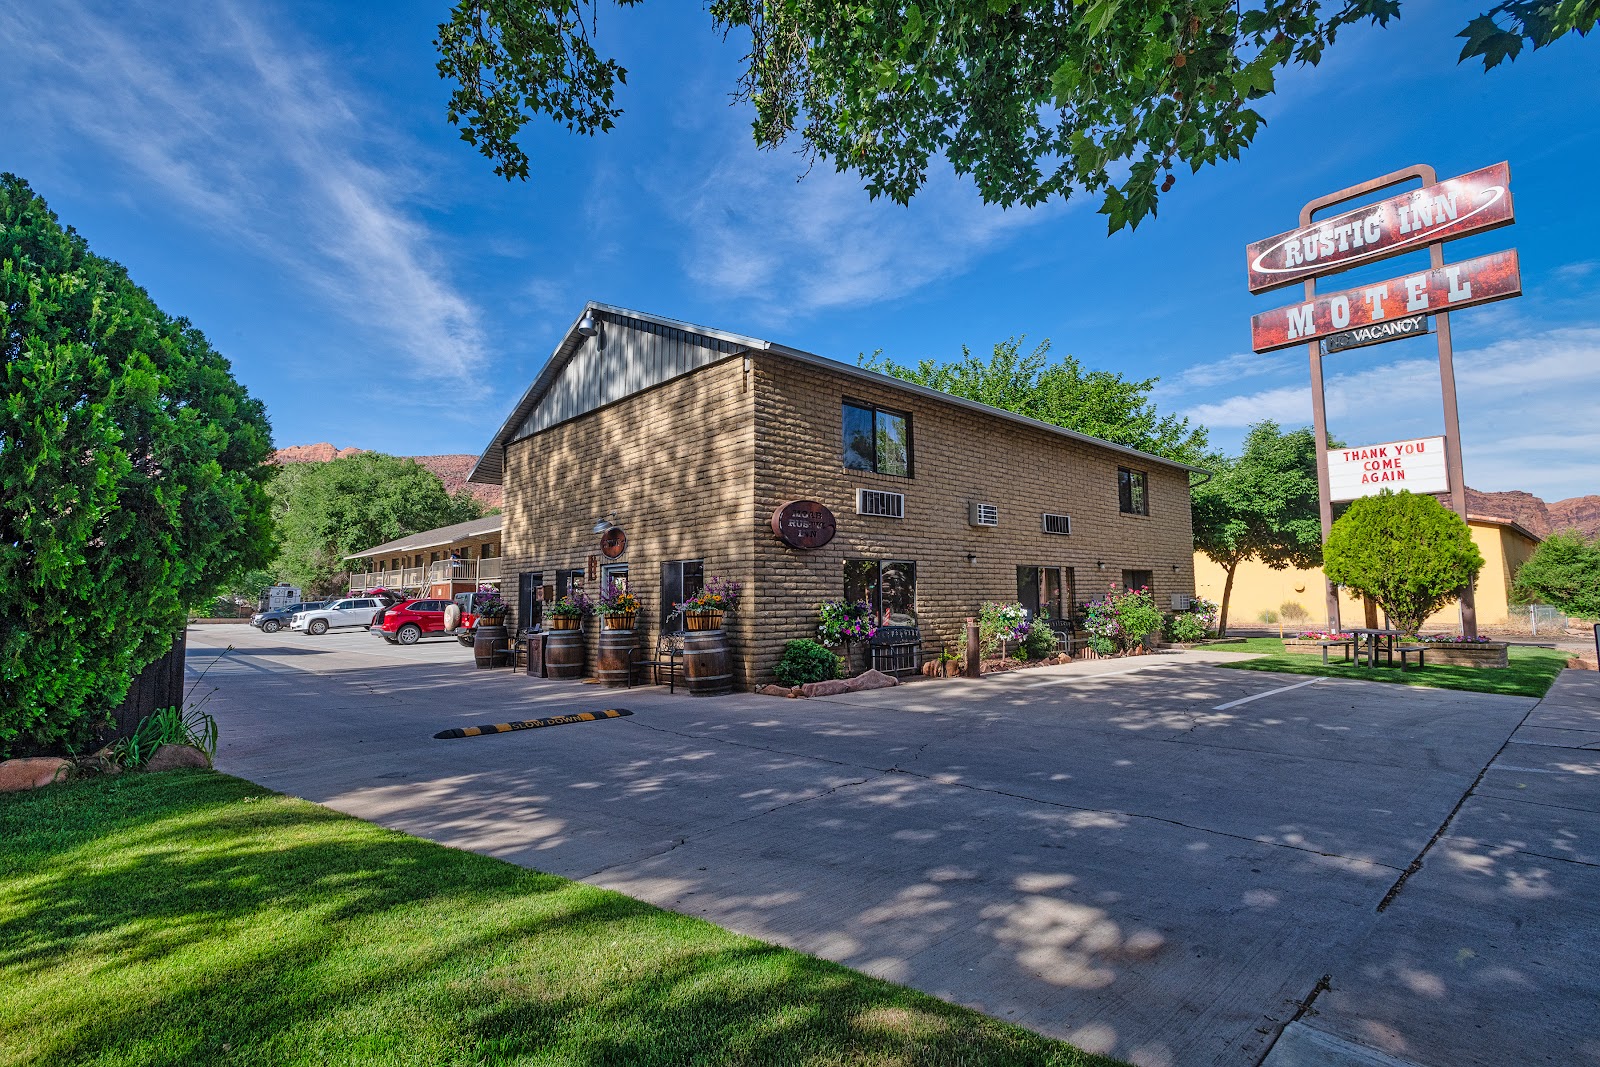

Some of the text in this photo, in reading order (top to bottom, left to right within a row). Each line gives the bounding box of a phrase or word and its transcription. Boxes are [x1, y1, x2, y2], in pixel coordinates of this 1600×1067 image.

[1285, 191, 1459, 269] RUSTIC INN
[1287, 265, 1472, 340] MOTEL
[1352, 316, 1422, 342] VACANCY
[1343, 442, 1425, 461] THANK YOU
[1364, 458, 1401, 471] COME
[1362, 470, 1405, 484] AGAIN
[512, 715, 581, 730] SLOW DOWN
